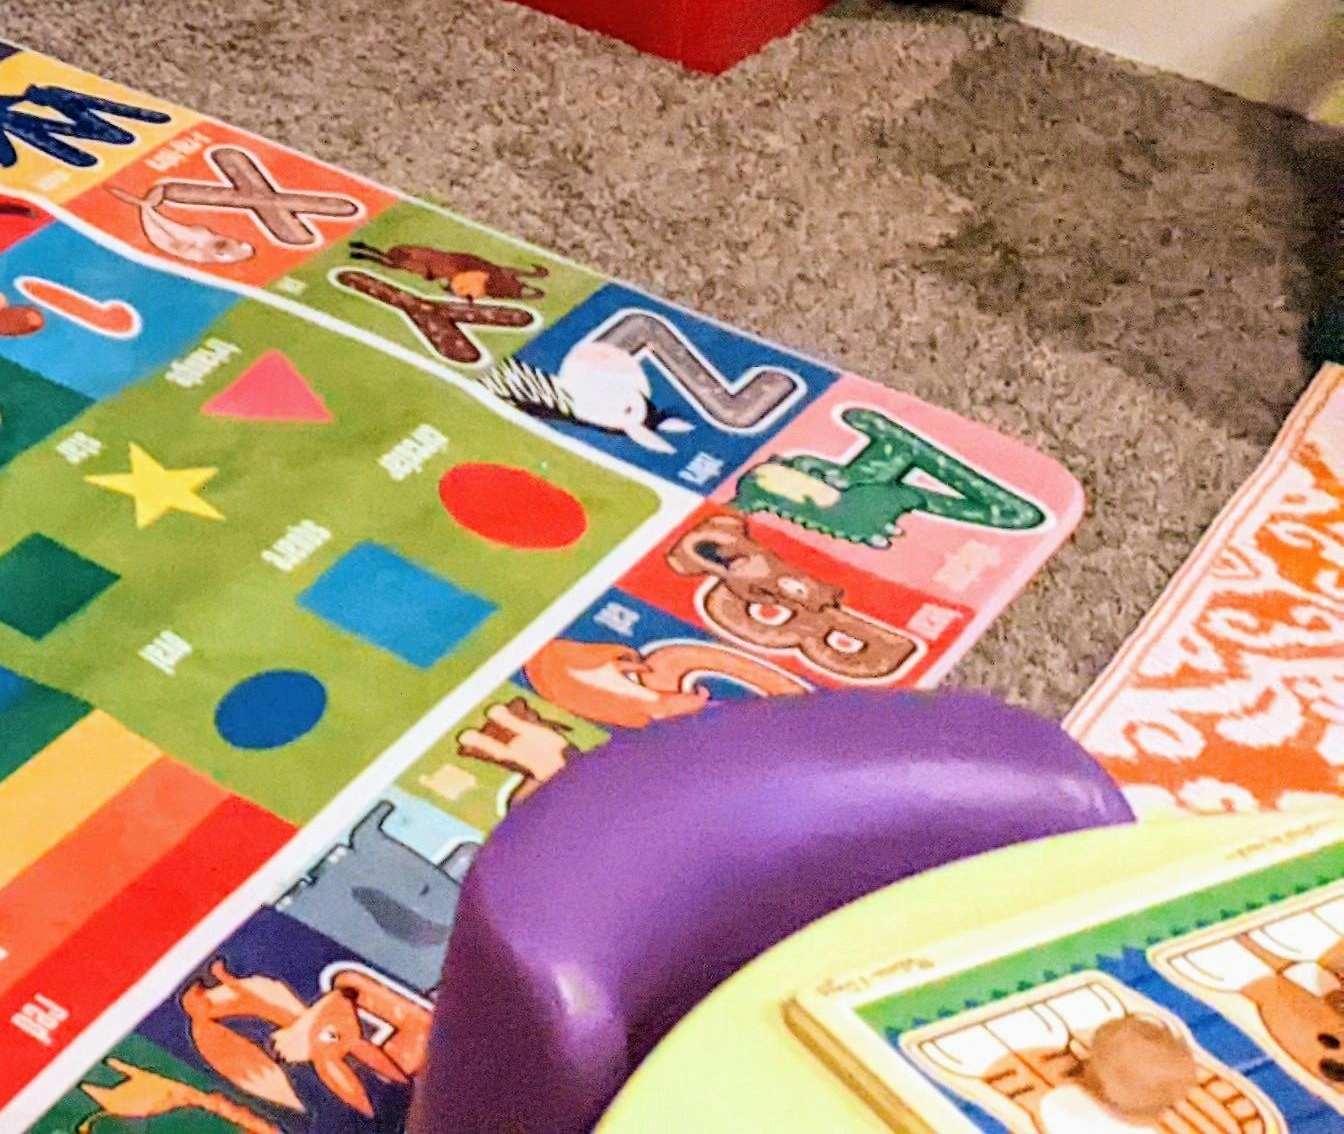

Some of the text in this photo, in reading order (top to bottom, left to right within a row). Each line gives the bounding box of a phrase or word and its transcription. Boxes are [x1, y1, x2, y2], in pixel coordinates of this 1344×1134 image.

[2, 83, 178, 169] W
[152, 142, 367, 248] X
[14, 275, 143, 341] 1
[327, 267, 544, 368] Y
[584, 308, 810, 434] Z
[802, 400, 1055, 532] A
[694, 576, 928, 685] B
[10, 992, 71, 1047] red
